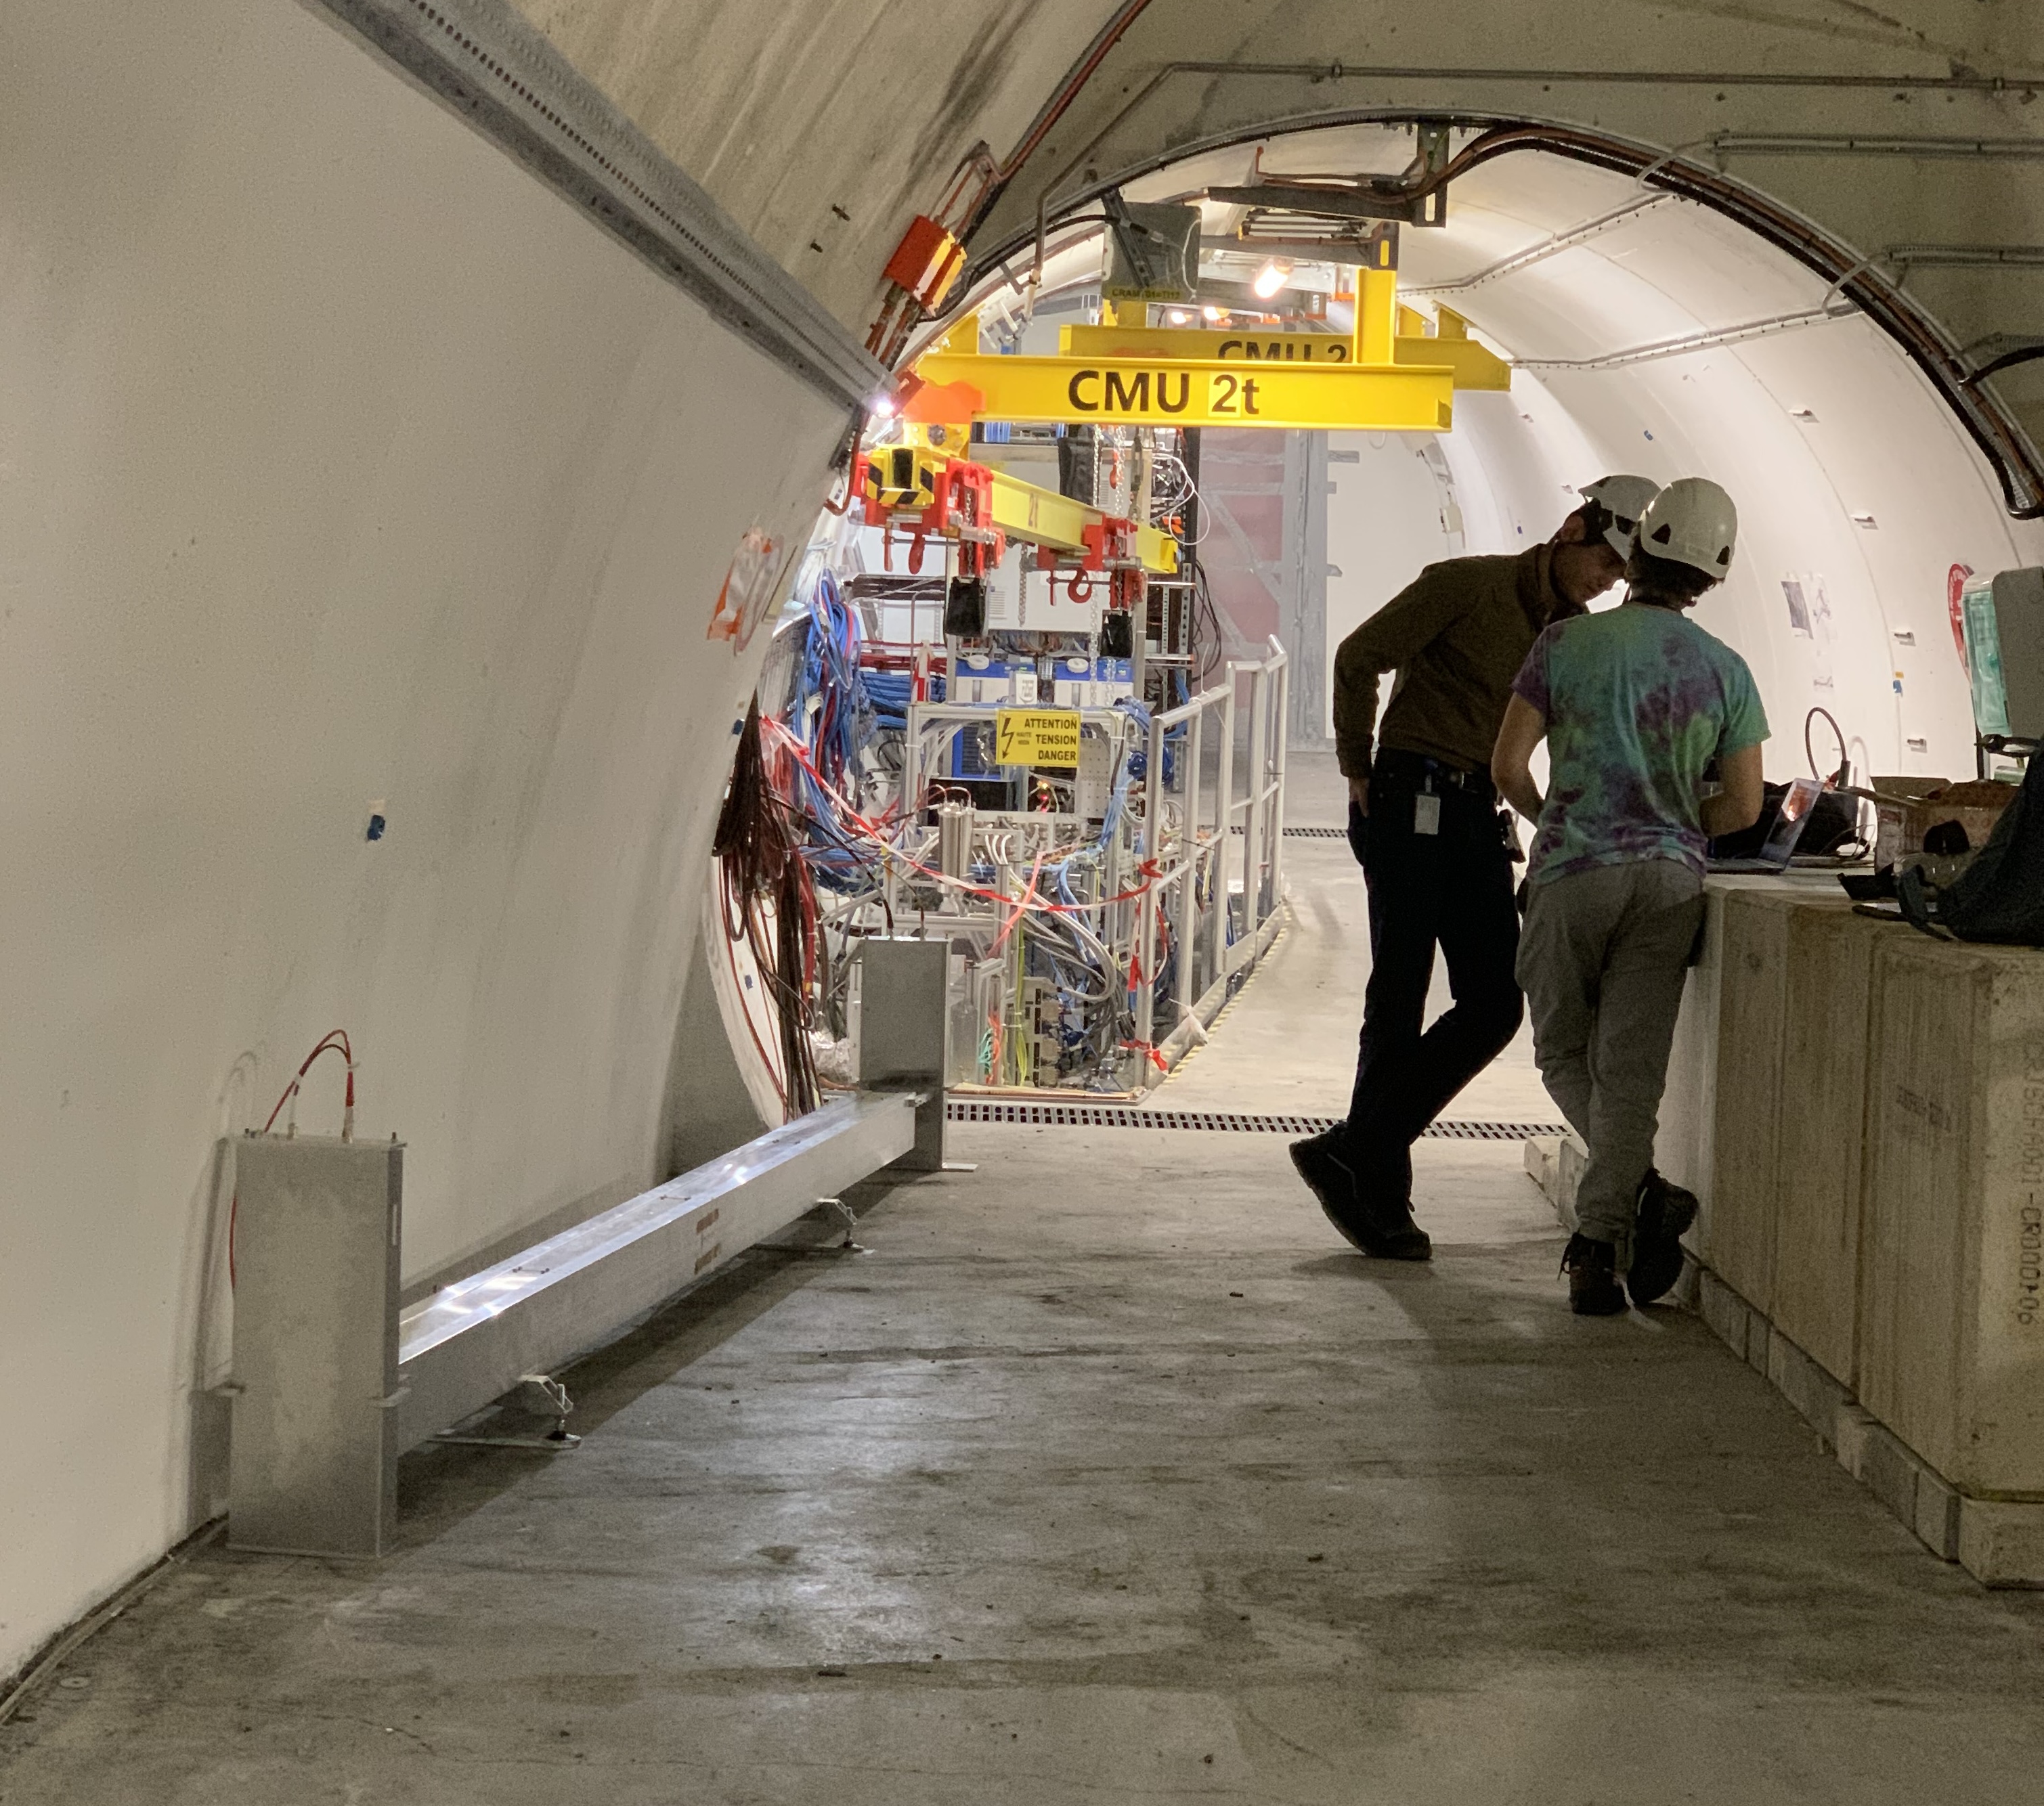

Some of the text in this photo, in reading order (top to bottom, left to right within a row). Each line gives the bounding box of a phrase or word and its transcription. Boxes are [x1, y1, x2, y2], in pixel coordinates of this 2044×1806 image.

[1217, 340, 1312, 362] CMU
[1068, 370, 1260, 414] CMU 2t
[1024, 718, 1077, 730] ATTENTION
[1035, 734, 1077, 745] TENSION
[1038, 750, 1076, 761] DANGER
